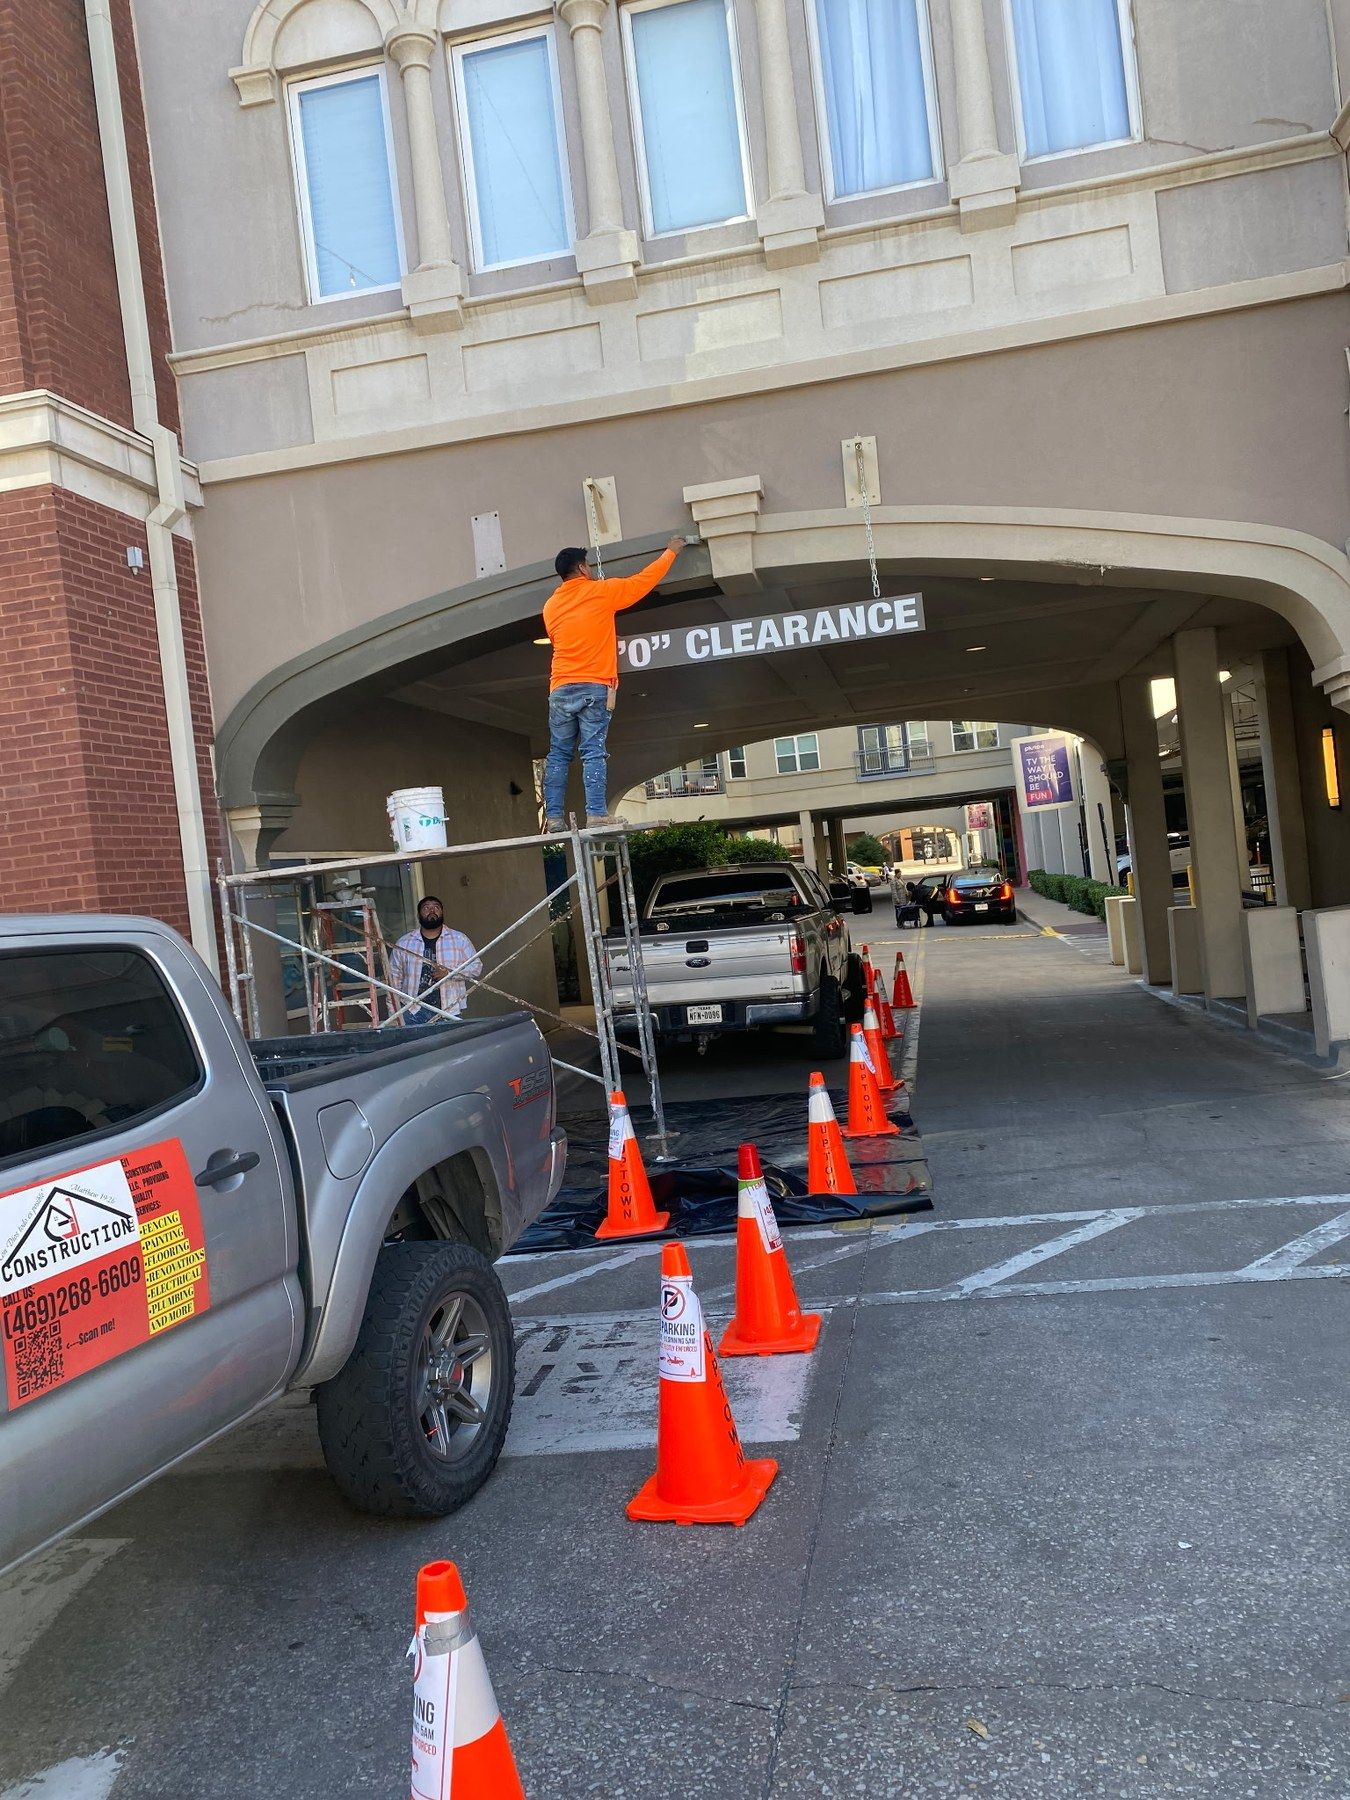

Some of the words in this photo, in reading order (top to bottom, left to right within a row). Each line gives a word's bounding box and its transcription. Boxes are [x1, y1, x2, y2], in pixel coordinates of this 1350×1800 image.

[685, 597, 919, 660] CLEARANCE
[1026, 757, 1038, 766] TV
[1039, 754, 1056, 764] THE
[1027, 764, 1047, 774] WAY
[1048, 763, 1056, 772] IT
[1028, 771, 1064, 783] SHOULD
[1029, 782, 1040, 791] BE
[1030, 791, 1048, 800] FUN
[820, 1124, 836, 1189] UPTOW
[125, 1159, 163, 1180] CONSTRUCTION
[141, 1212, 179, 1235] FENCING
[1, 1218, 134, 1282] CONSTRUCTION
[144, 1227, 184, 1251] PAINTING
[147, 1241, 190, 1267] FLOORING
[148, 1249, 205, 1283] RENOVATIONS
[150, 1267, 201, 1298] ELECTRICAL
[2, 1293, 21, 1308] CALL
[3, 1256, 141, 1340] (469)268-6609
[151, 1287, 194, 1315] PLUMBING
[101, 1318, 116, 1336] me!
[151, 1315, 168, 1331] AND
[169, 1302, 193, 1323] MORE
[704, 1337, 746, 1469] UPTOWN
